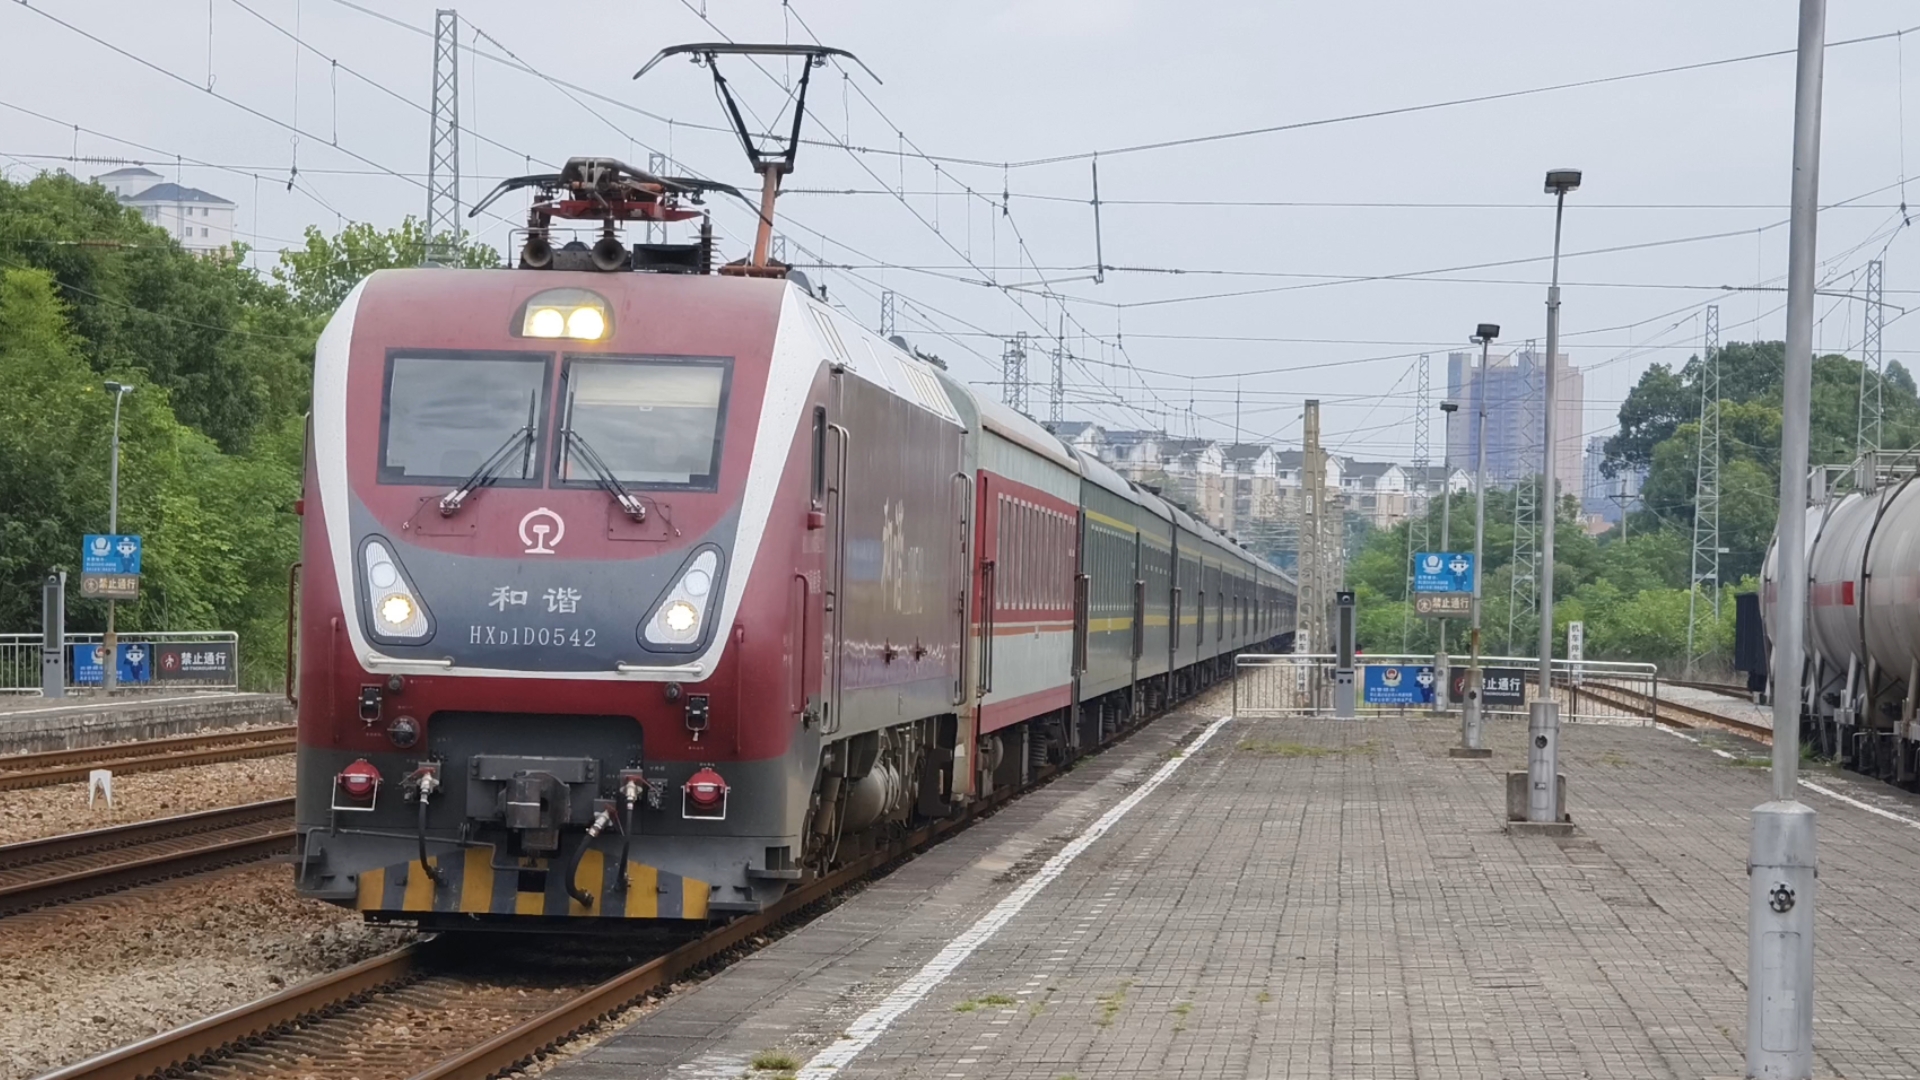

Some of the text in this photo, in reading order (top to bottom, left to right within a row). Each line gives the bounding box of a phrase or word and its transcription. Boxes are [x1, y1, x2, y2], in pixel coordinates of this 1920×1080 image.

[99, 577, 135, 589] 禁止通行
[488, 585, 582, 613] 和谐
[1432, 597, 1469, 609] 禁止通行
[470, 626, 597, 647] HXD1D0542
[181, 652, 226, 665] 禁止通行
[1571, 625, 1580, 680] 机车停车
